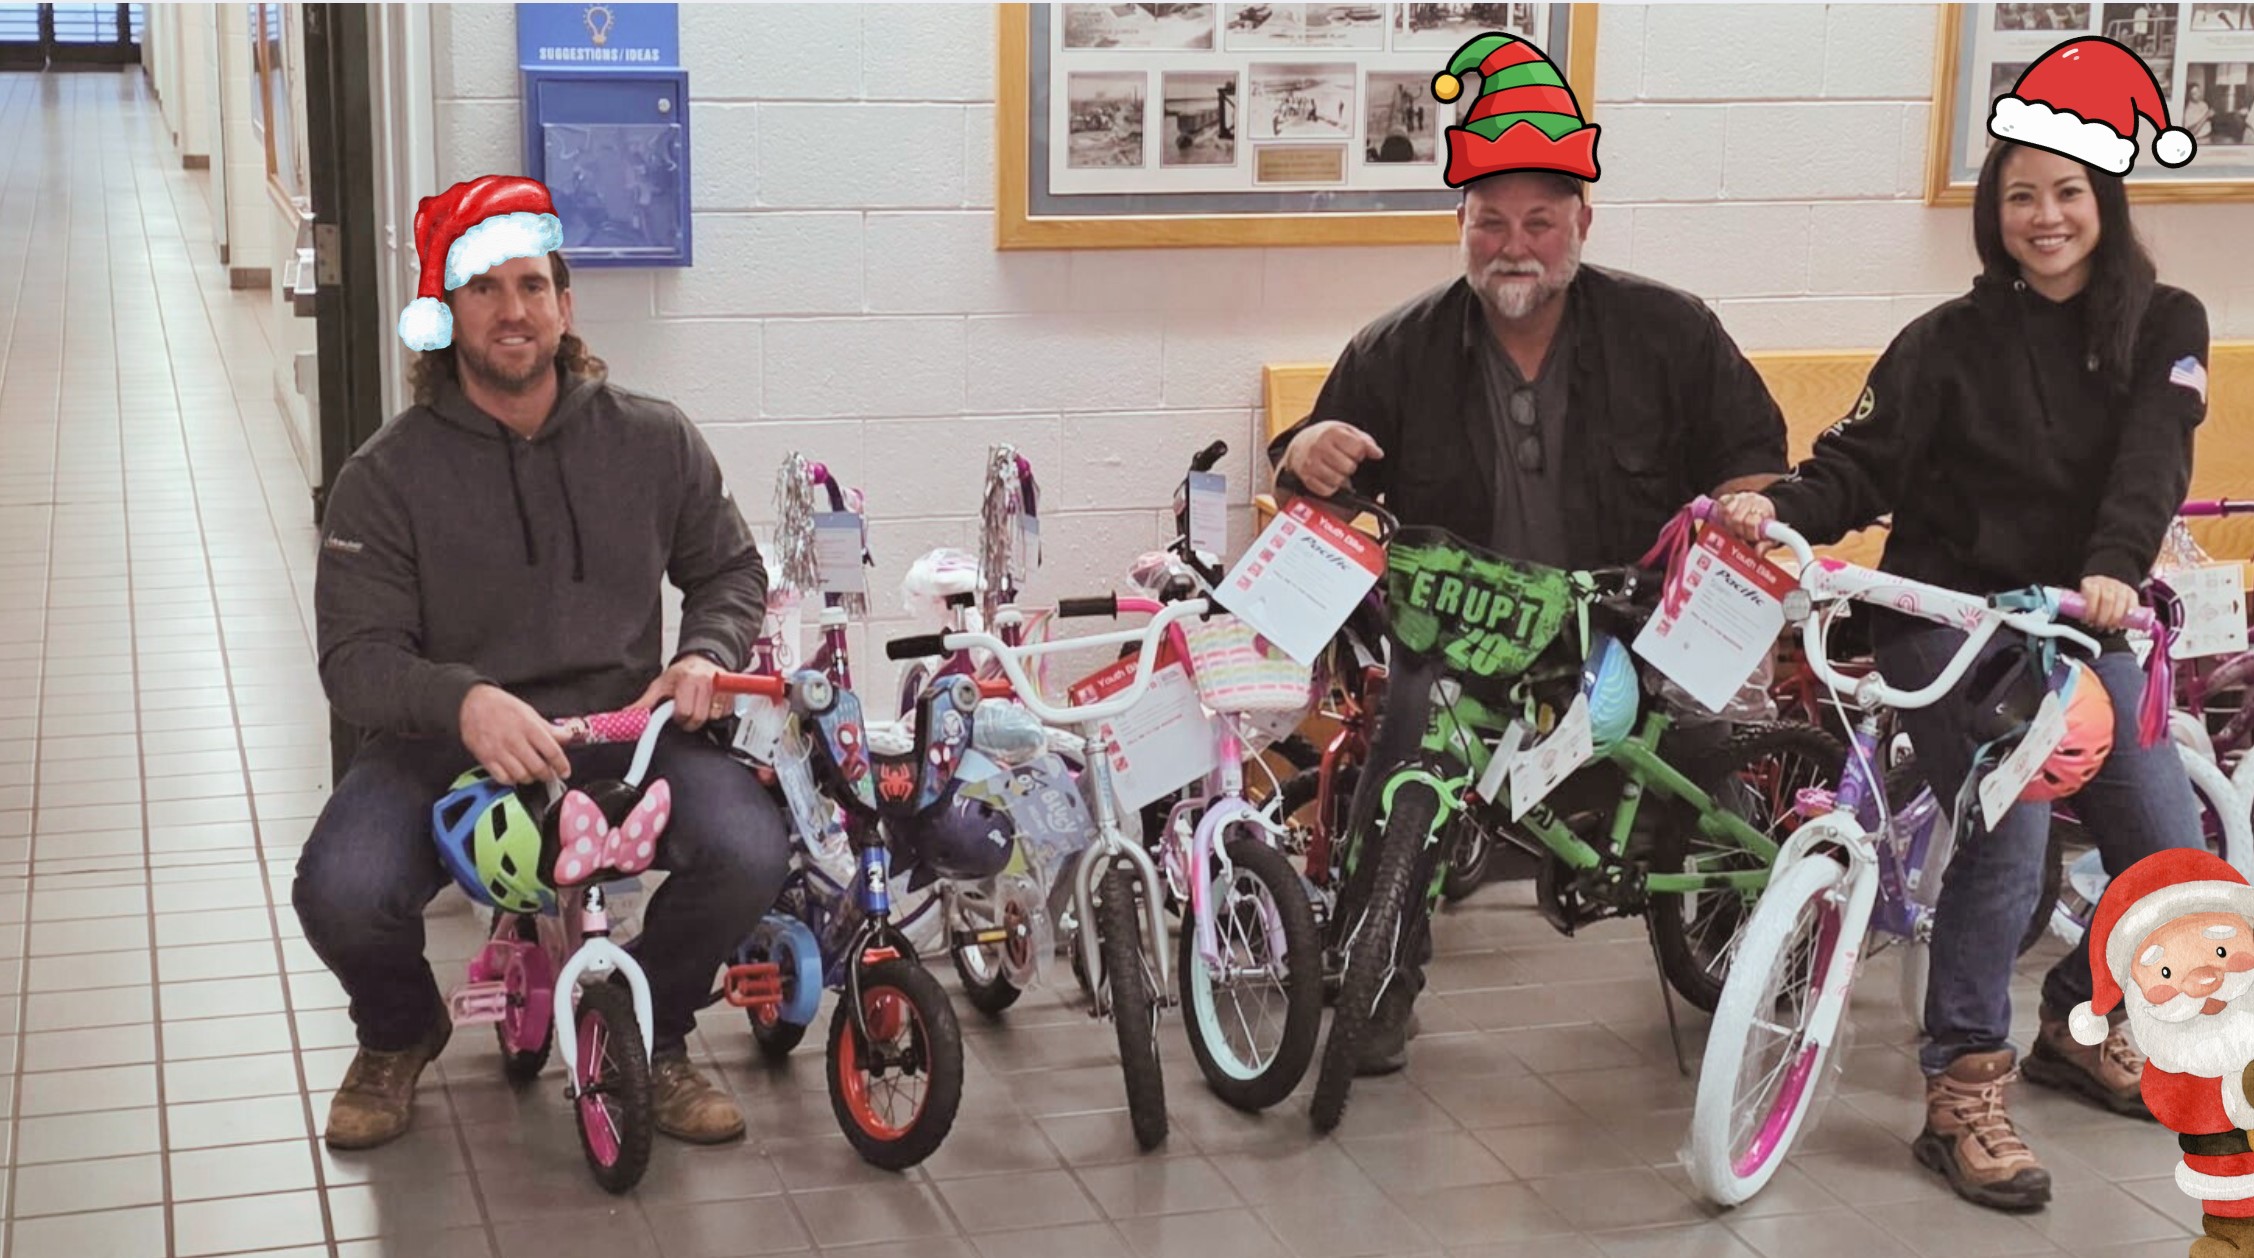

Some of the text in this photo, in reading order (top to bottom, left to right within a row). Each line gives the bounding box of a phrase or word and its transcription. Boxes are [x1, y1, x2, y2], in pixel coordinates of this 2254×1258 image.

[1301, 535, 1350, 571] Pacific
[1318, 515, 1366, 553] Youth Bike
[1730, 545, 1778, 584] Youth Bike
[1409, 569, 1539, 639] ERUPT
[1715, 569, 1765, 607] Pacific
[1097, 667, 1126, 689] Youth
